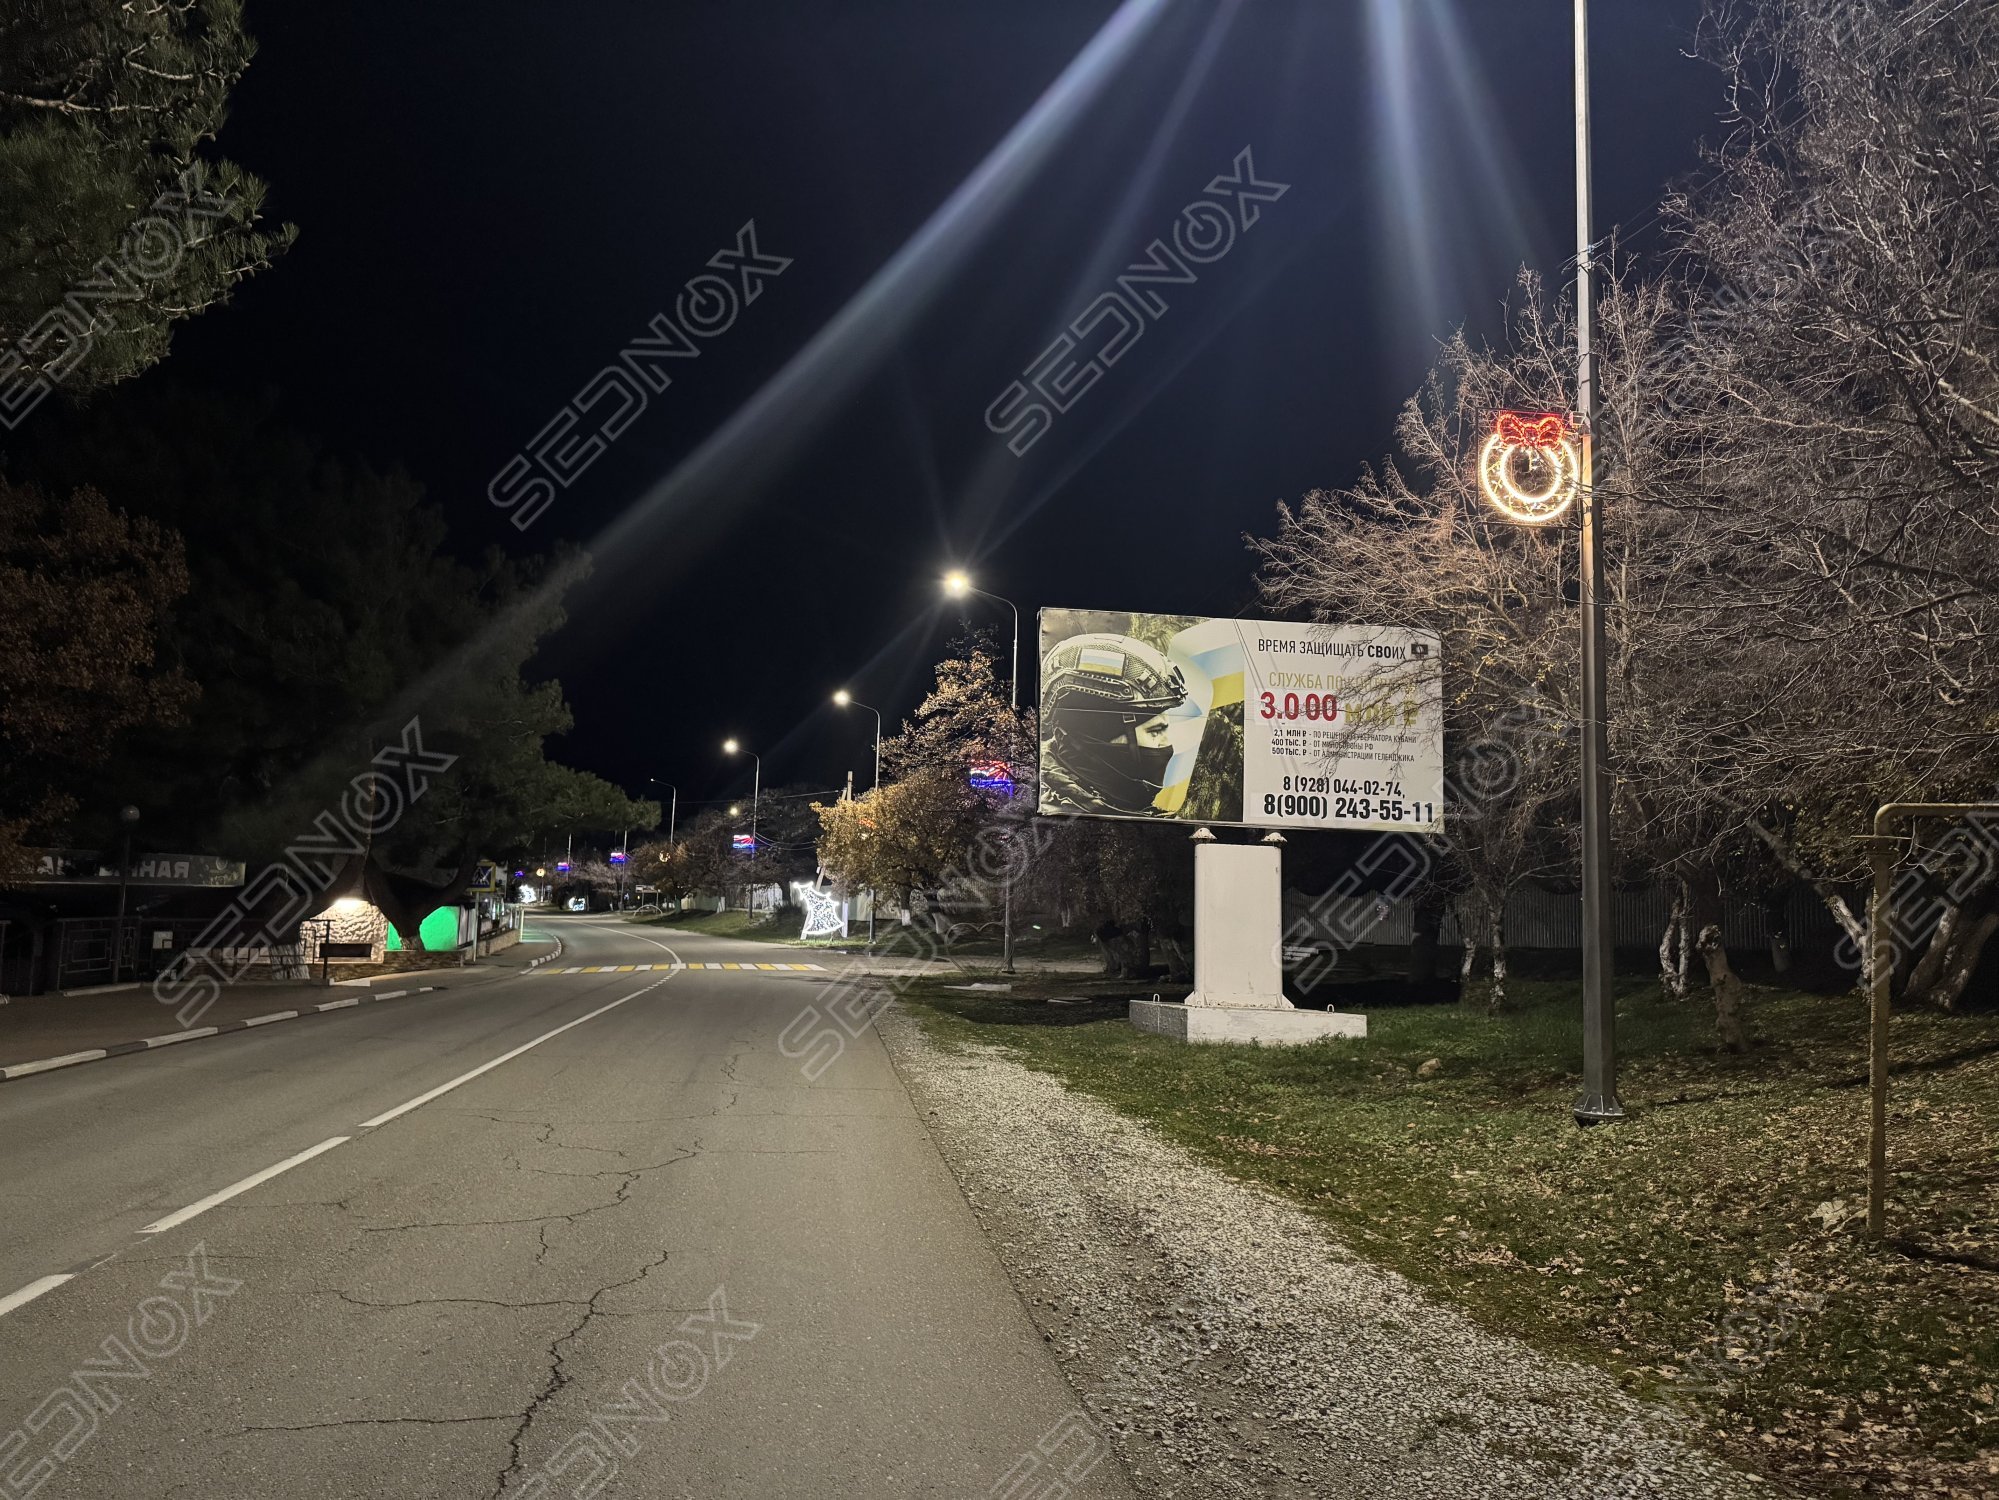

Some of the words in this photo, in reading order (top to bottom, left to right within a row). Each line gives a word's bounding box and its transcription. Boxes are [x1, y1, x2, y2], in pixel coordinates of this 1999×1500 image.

[1258, 638, 1296, 654] ВРЕМЯ
[1300, 640, 1364, 658] ЗАЩИЩАТЬ
[1367, 645, 1406, 660] СВОИХ
[1269, 671, 1322, 690] СЛУЖБА
[1326, 674, 1343, 691] ПО
[1260, 691, 1338, 722] 3.000
[1271, 738, 1284, 746] 400
[1285, 738, 1302, 747] ТЫС.
[1313, 740, 1321, 748] ОТ
[1364, 743, 1374, 751] РФ
[1274, 729, 1283, 738] 2,1
[1286, 729, 1301, 737] МЛН
[1313, 730, 1322, 739] ПО
[1393, 735, 1417, 744] КУБАНИ
[1271, 747, 1284, 755] 500
[1285, 748, 1302, 756] ТЫС.
[1374, 752, 1415, 762] ГЕЛЕНДЖИКА
[1283, 775, 1291, 791] 8
[1294, 776, 1330, 795] (928)
[1333, 778, 1405, 799] 044-02-74,
[1263, 793, 1328, 820] 8(900)
[1334, 797, 1433, 823] 243-55-11
